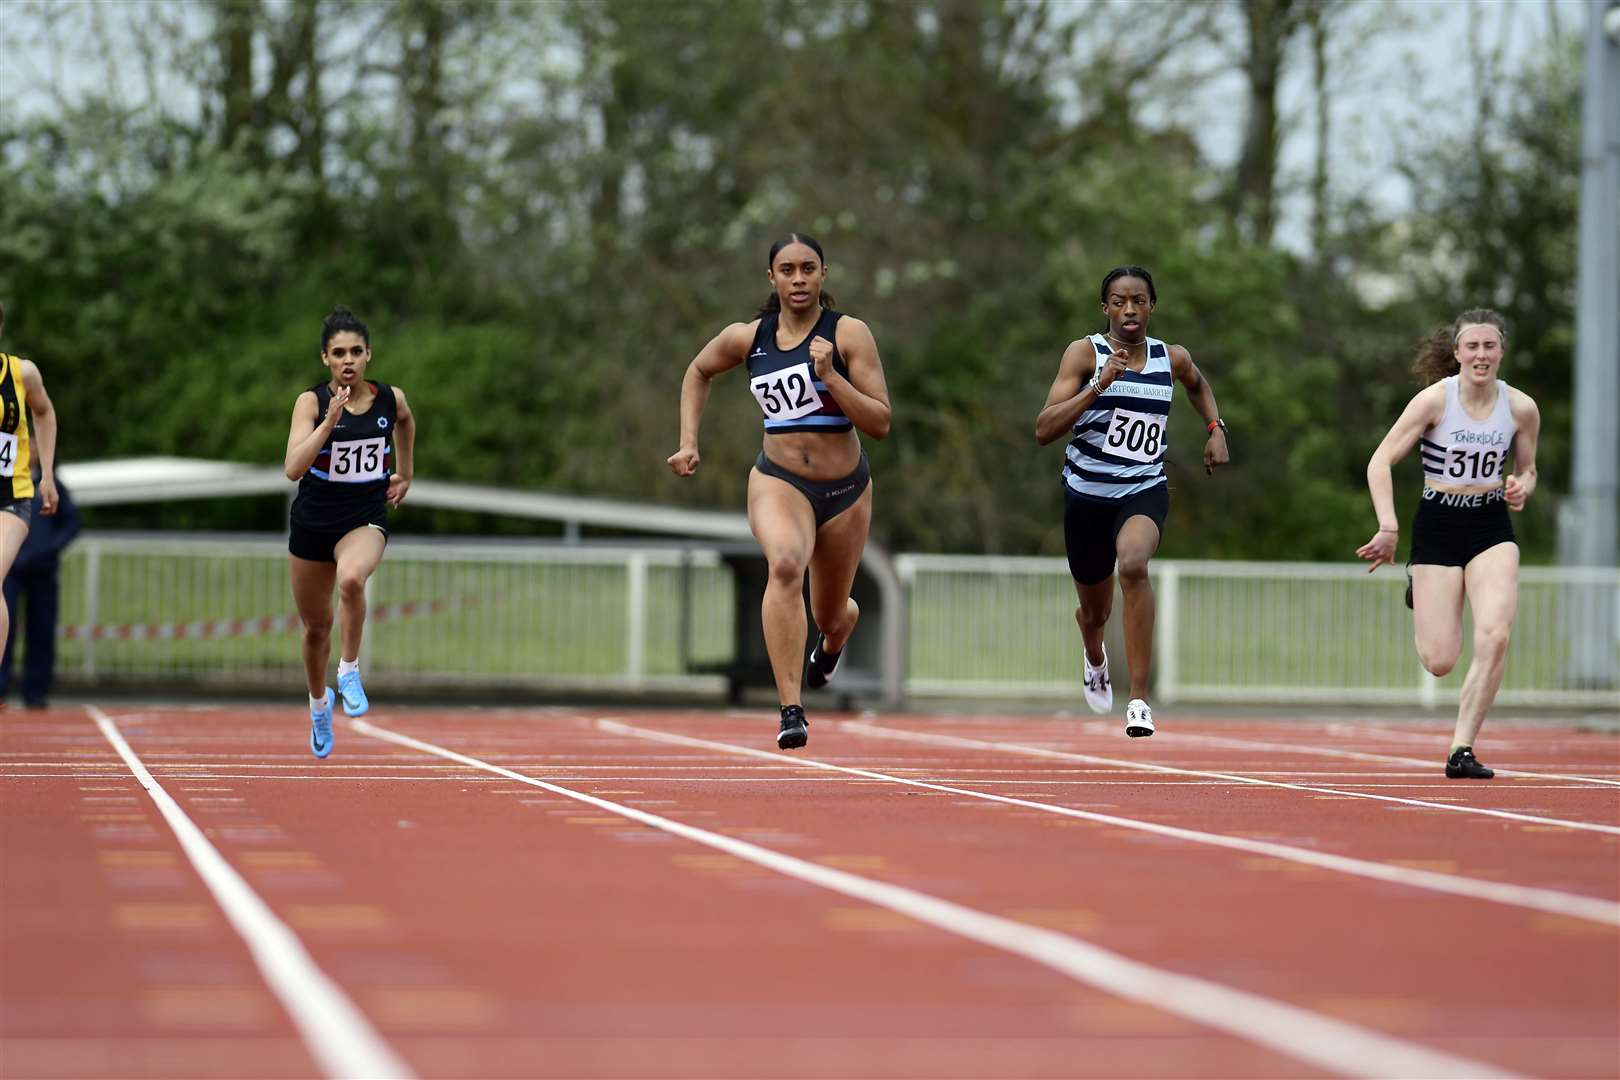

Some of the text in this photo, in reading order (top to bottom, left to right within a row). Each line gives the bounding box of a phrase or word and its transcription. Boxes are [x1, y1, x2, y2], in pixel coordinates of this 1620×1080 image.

[756, 373, 814, 413] 312
[1104, 384, 1140, 395] ARTFORD
[1108, 415, 1160, 456] 308
[334, 444, 379, 475] 313
[1449, 450, 1498, 479] 316
[1440, 492, 1483, 508] NIKE
